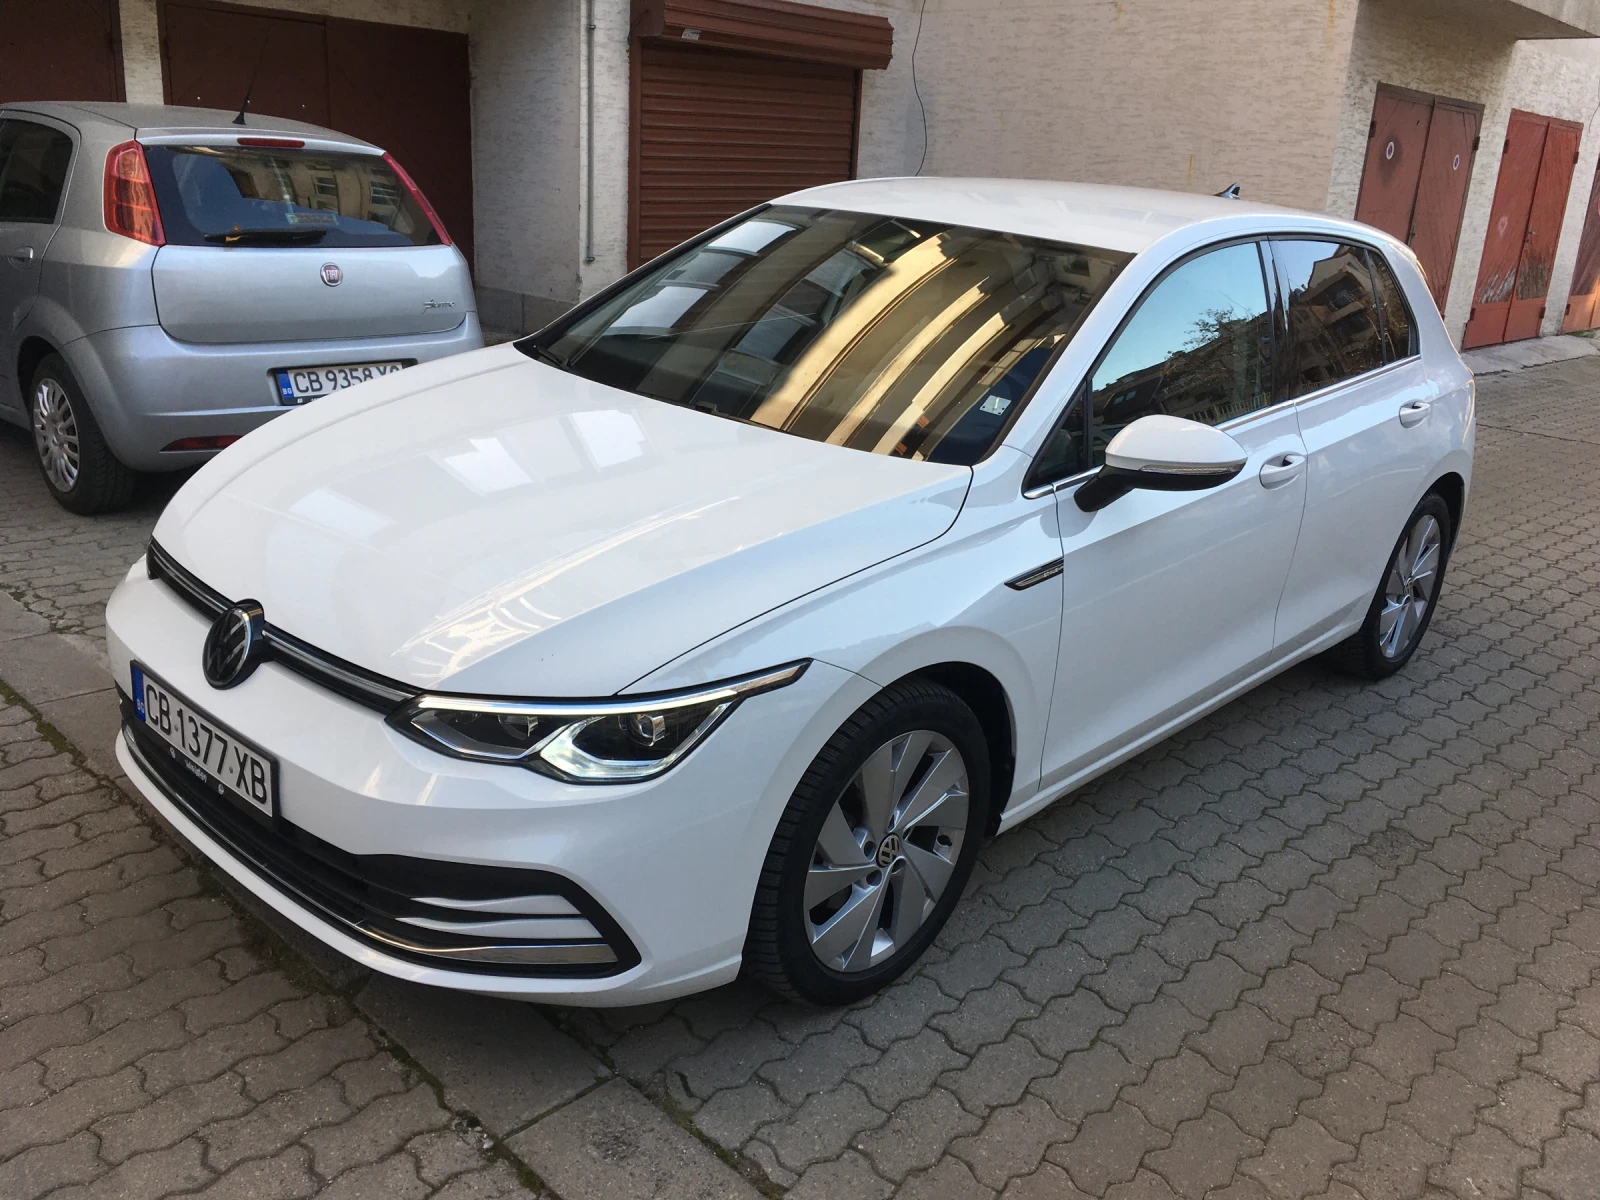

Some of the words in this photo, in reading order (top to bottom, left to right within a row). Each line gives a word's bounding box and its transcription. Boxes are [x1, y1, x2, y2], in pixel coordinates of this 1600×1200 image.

[325, 269, 339, 281] FIAT
[293, 370, 323, 393] CB
[325, 367, 374, 390] 9358
[282, 387, 292, 395] BG
[146, 684, 171, 736] CB
[177, 708, 228, 775] 1377
[234, 746, 267, 805] XB
